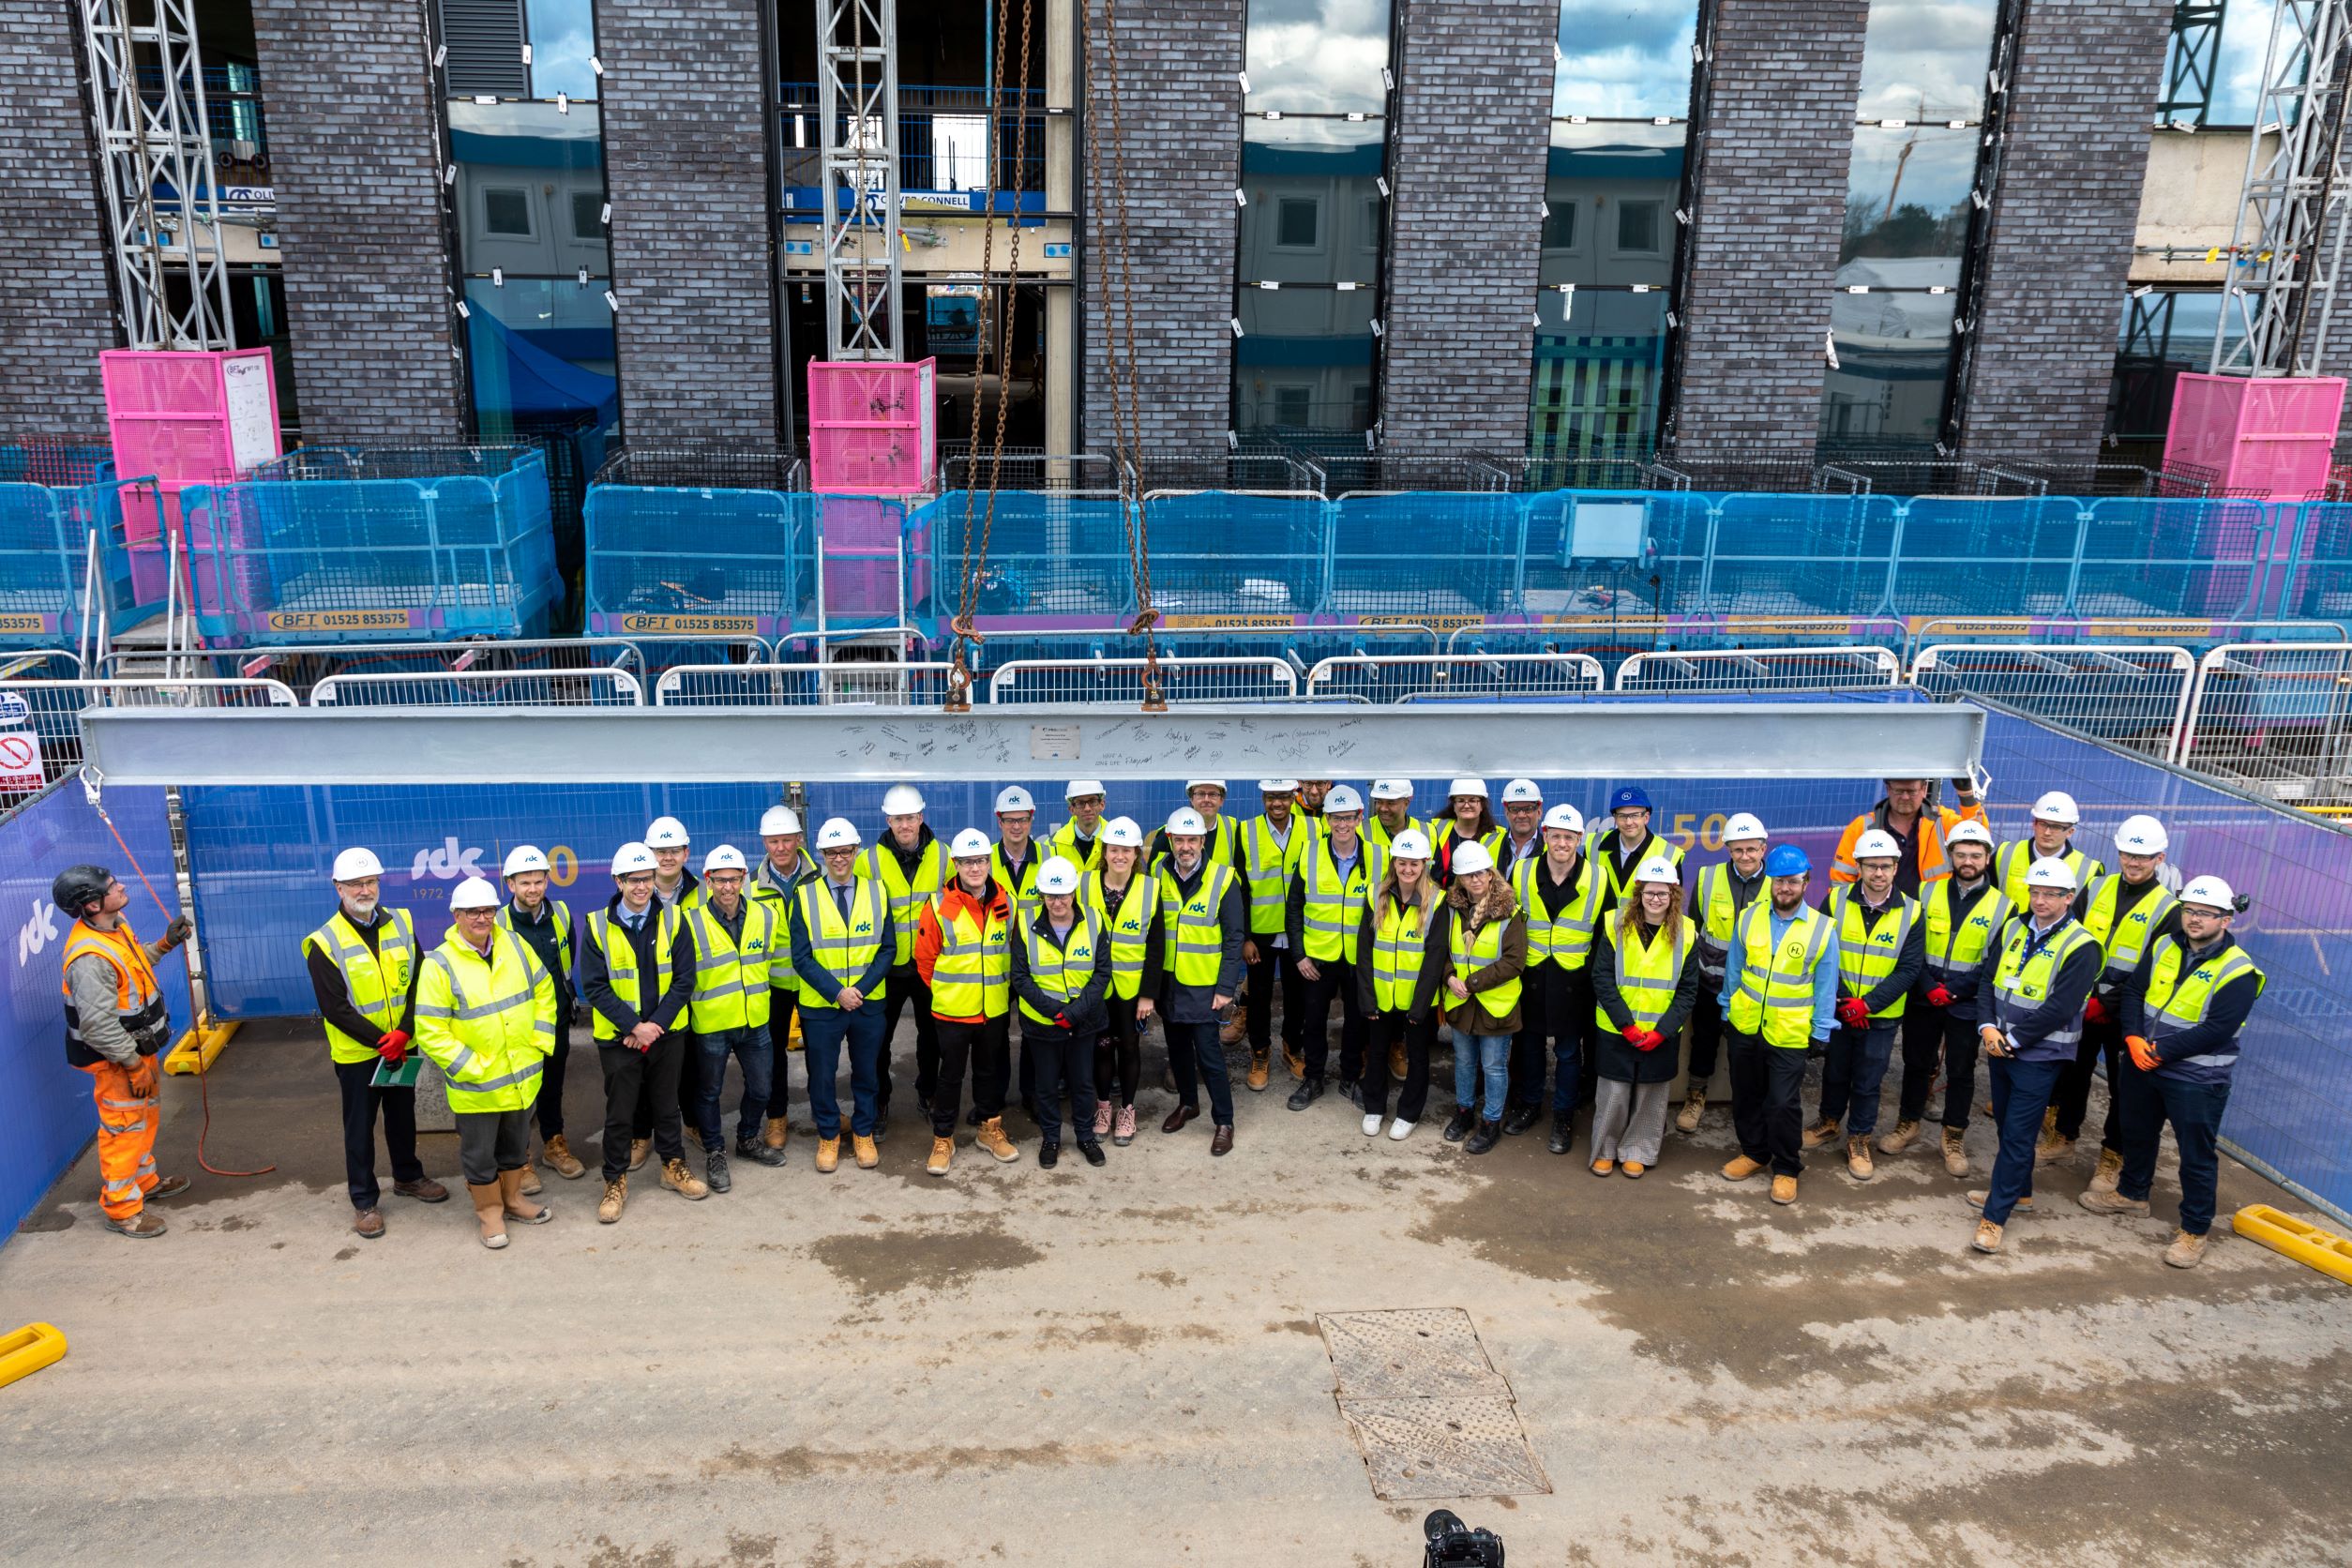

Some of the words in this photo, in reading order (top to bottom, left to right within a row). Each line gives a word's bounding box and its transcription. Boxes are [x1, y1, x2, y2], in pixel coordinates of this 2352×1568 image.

[283, 613, 318, 626] BFT
[324, 614, 359, 626] 01525
[363, 613, 406, 625] 853575
[636, 616, 670, 627] BFT
[675, 618, 710, 629] 01525
[713, 619, 754, 630] 853575
[1673, 813, 1726, 852] 50
[413, 888, 444, 899] 1972
